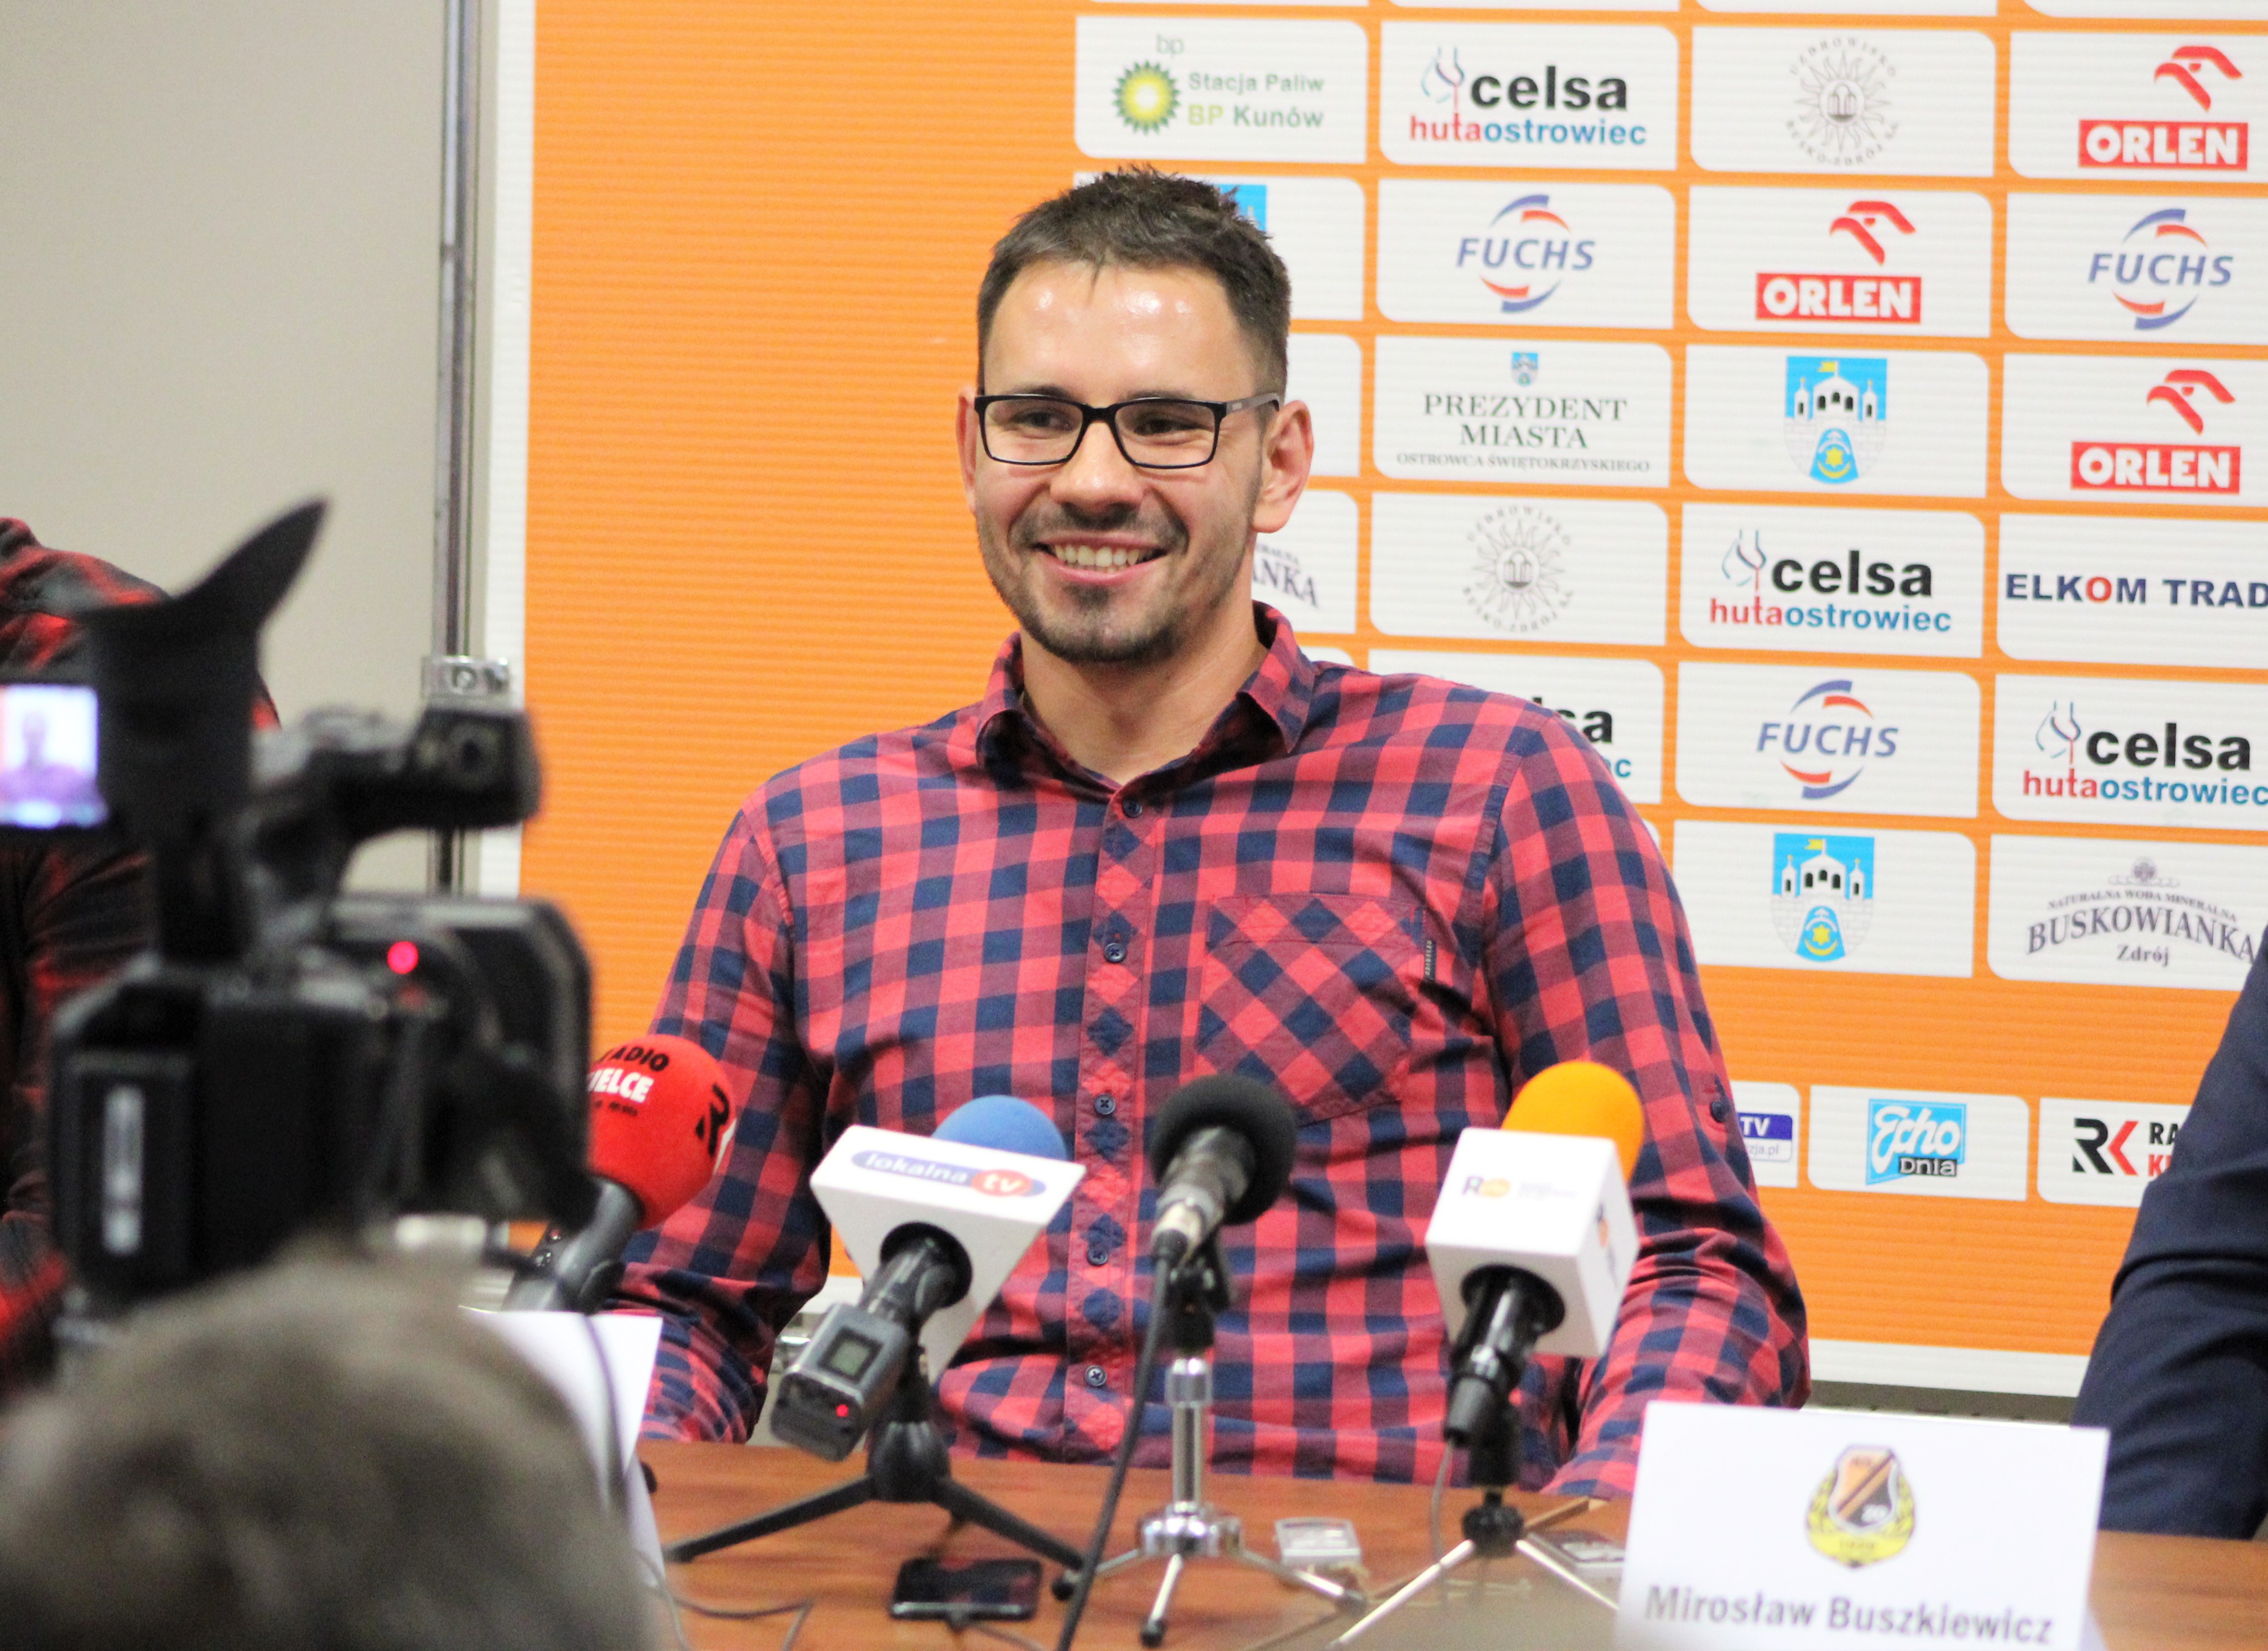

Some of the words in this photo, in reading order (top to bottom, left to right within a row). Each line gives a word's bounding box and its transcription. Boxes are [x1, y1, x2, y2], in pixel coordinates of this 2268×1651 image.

[1156, 34, 1185, 56] bp
[1189, 72, 1257, 95] Stacja
[1265, 73, 1324, 93] Paliw
[1470, 65, 1627, 111] celsa
[1188, 104, 1224, 126] BP
[1233, 105, 1324, 128] Kunów
[1410, 113, 1646, 145] hutaostrowiec
[2086, 127, 2238, 165] ORLEN
[1456, 237, 1595, 271] FUCHS
[2089, 253, 2234, 287] FUCHS
[1763, 279, 1912, 318] ORLEN
[1424, 393, 1628, 422] PREZYDENT
[1461, 424, 1589, 449] MIASTA
[1397, 453, 1483, 467] OSTROWCA
[1488, 453, 1650, 473] ŚWIĘTOKRZYSKIEGO
[2079, 451, 2230, 488] ORLEN
[1772, 551, 1933, 598] celsa
[2006, 573, 2147, 605] ELKOM
[2162, 578, 2268, 609] TRAD
[1710, 595, 1951, 632] hutaostrowiec
[1757, 723, 1898, 757] FUCHS
[2087, 722, 2251, 771] celsa
[2023, 769, 2268, 807] hutaostrowiec
[2048, 890, 2121, 910] NATURALNA
[2125, 889, 2161, 901] WODA
[2165, 893, 2236, 922] MINERALNA
[2027, 906, 2256, 965] BUSKOWIANKA
[2117, 945, 2169, 967] Zdrój
[606, 1046, 669, 1071] ADIO
[1740, 1116, 1770, 1136] TV
[1872, 1106, 1961, 1174] Echo
[864, 1152, 969, 1184] lokalna
[983, 1173, 1024, 1193] tv
[1644, 1584, 1817, 1630] Mirosław
[1828, 1596, 2053, 1645] Buszkiewicz
